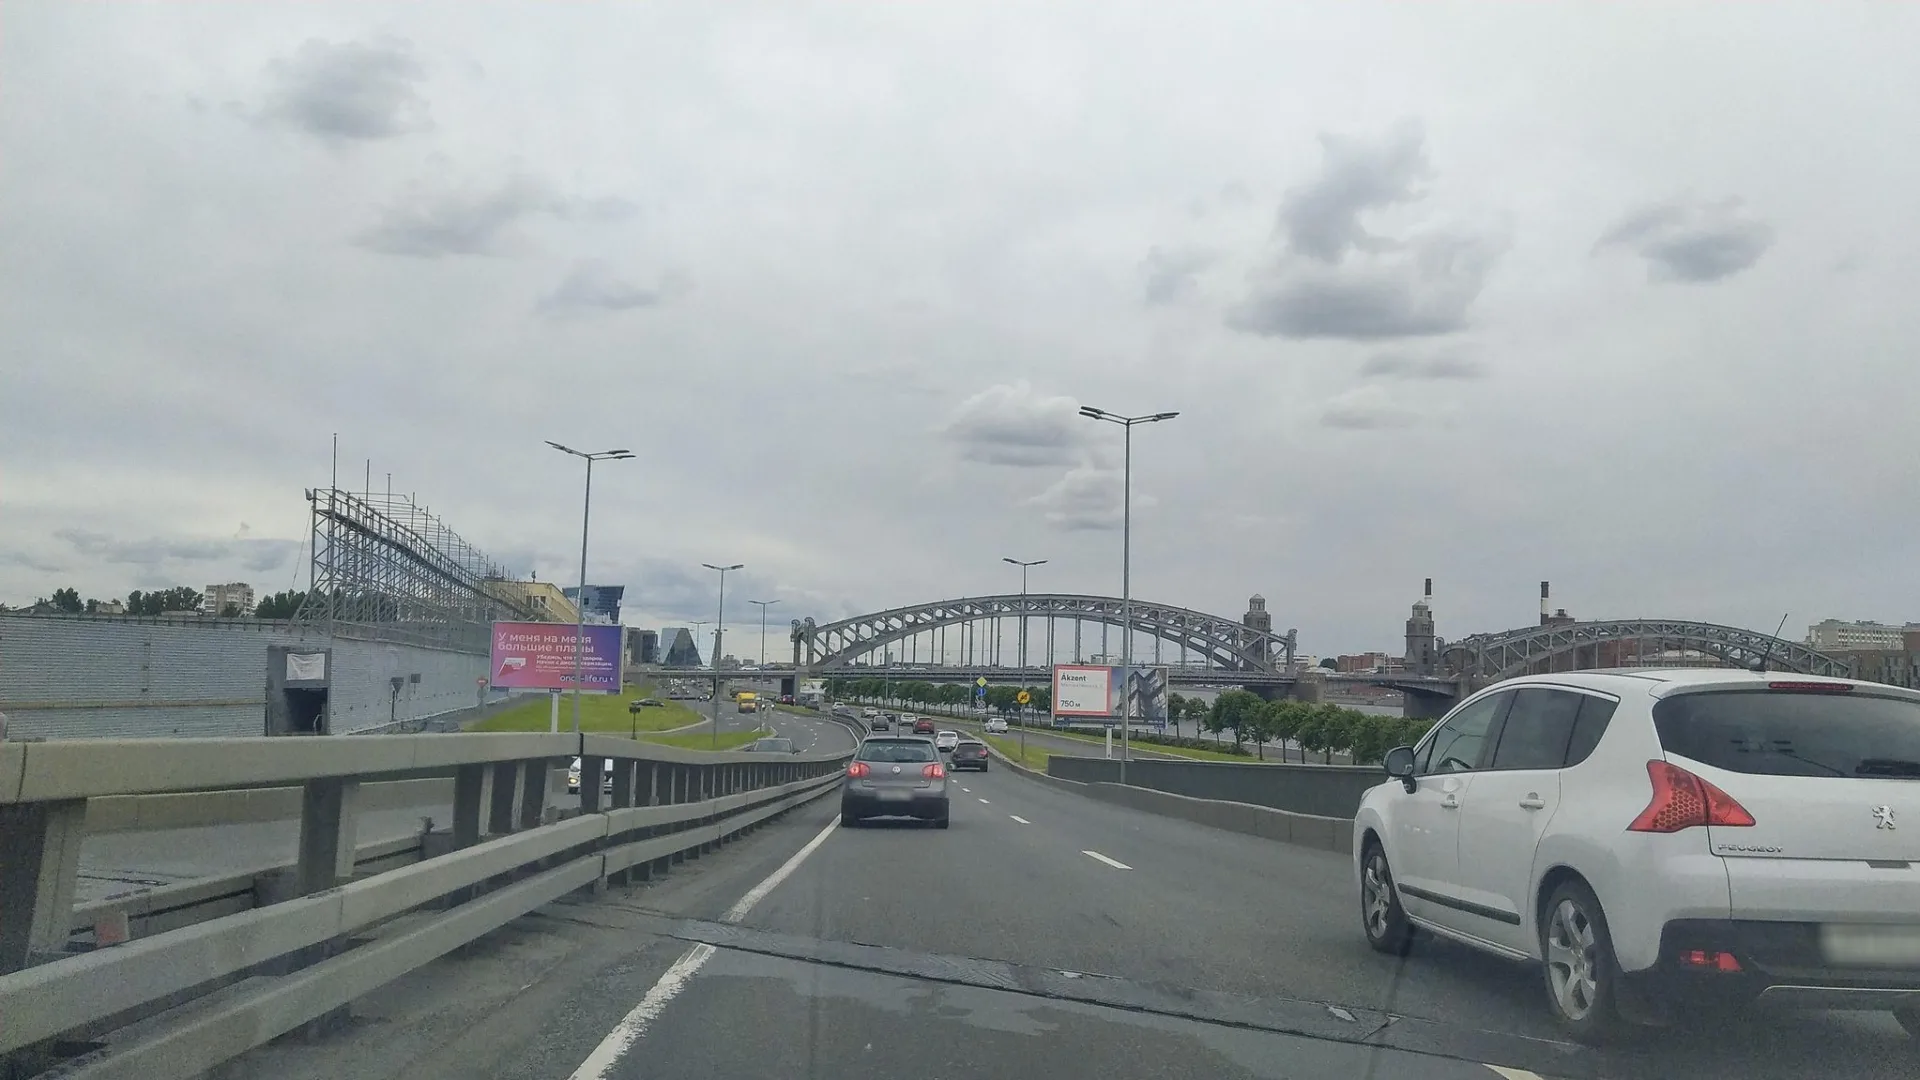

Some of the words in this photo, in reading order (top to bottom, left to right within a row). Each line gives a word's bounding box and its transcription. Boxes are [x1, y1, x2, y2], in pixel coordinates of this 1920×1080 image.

[498, 632, 507, 641] У
[509, 634, 540, 643] меня
[498, 641, 553, 652] большие
[560, 674, 608, 683] onc-life.ru
[1060, 699, 1075, 708] 750
[1718, 844, 1783, 853] PEUGEOT
